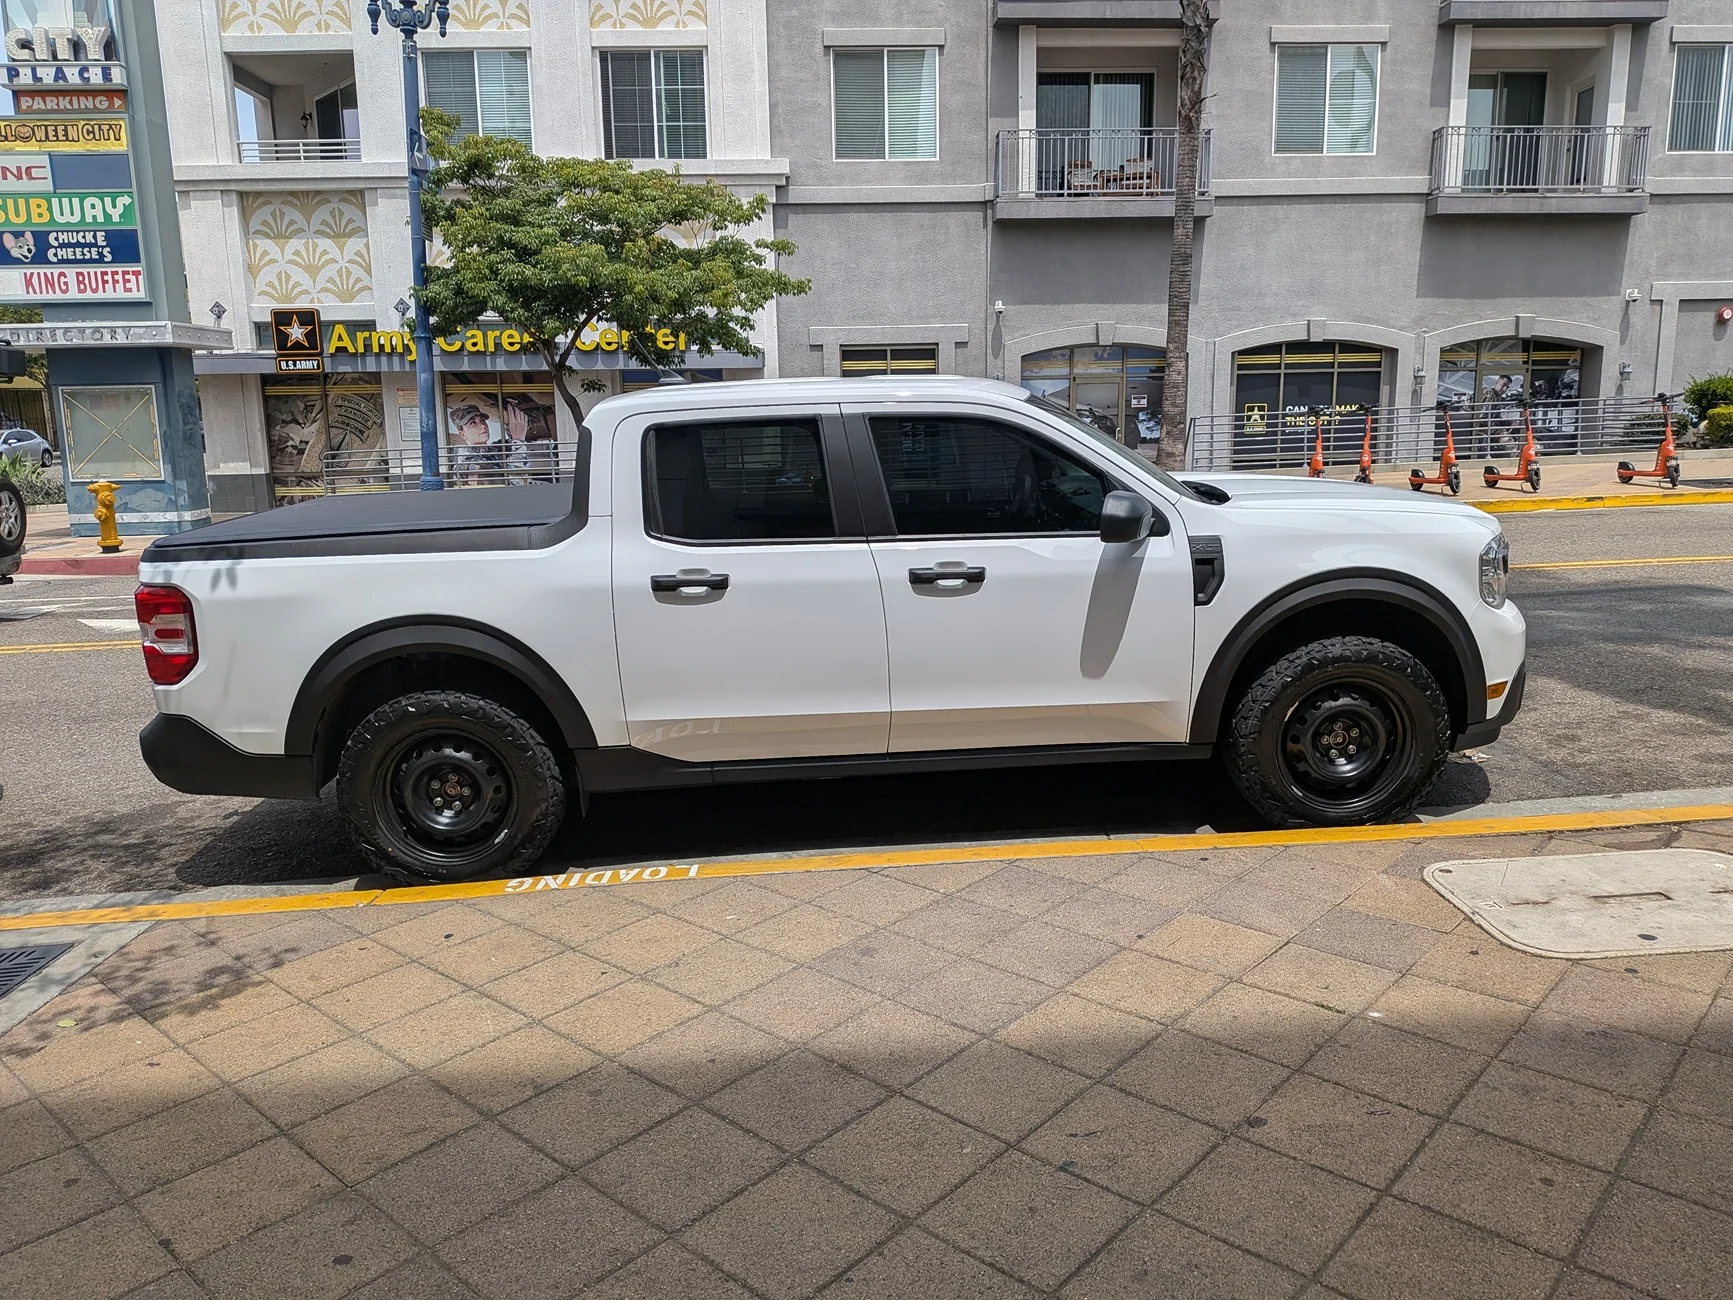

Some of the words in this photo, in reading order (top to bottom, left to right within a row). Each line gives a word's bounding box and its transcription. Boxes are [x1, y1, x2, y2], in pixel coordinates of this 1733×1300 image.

[5, 27, 111, 61] CITY
[20, 95, 109, 110] PARKING
[82, 122, 122, 141] CITY
[48, 231, 96, 247] CHUCK
[96, 231, 107, 247] E
[47, 247, 113, 263] CHEESE'S
[23, 271, 70, 295] KING
[75, 269, 142, 294] BUFFET
[9, 327, 132, 344] DIRECTORY
[280, 359, 318, 370] U.S.ARMY
[340, 397, 362, 408] SPECIAL
[343, 409, 370, 424] RANGER
[1285, 416, 1305, 426] THE
[334, 419, 366, 437] AIRBORNE
[504, 864, 700, 892] LOADING
